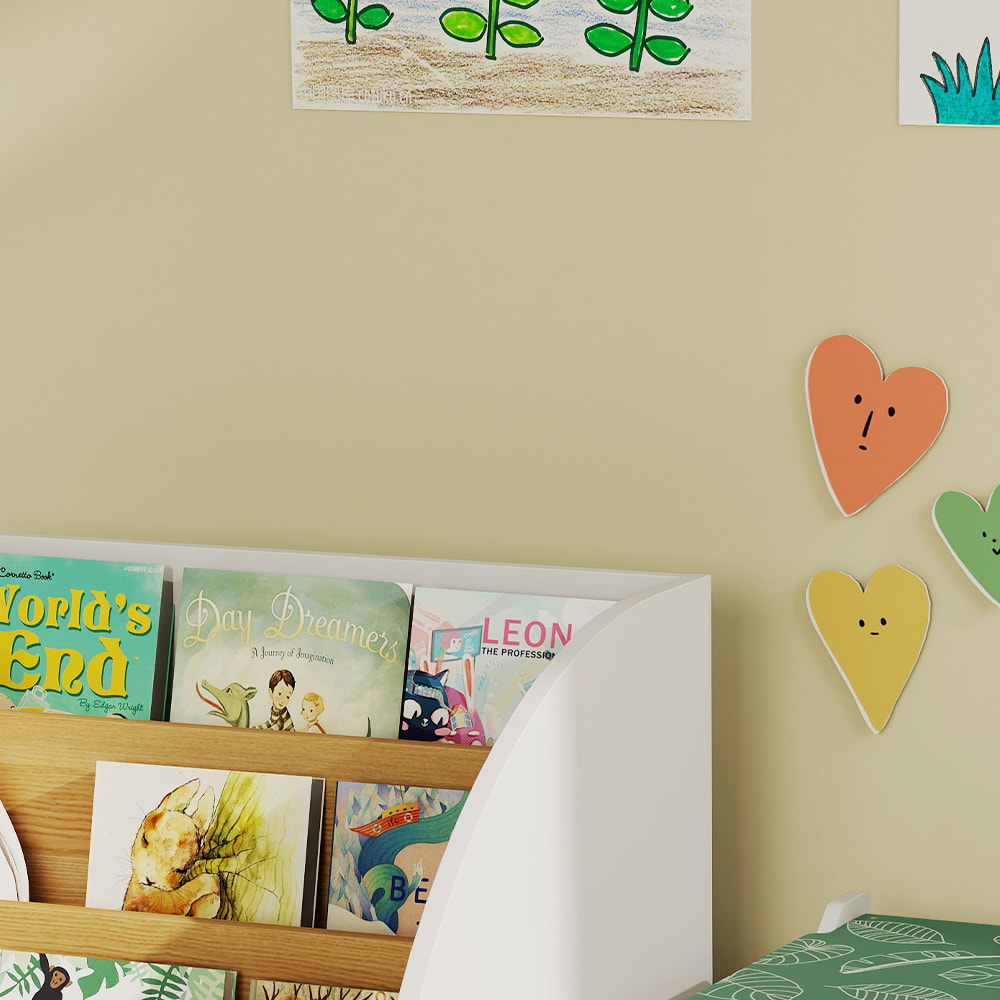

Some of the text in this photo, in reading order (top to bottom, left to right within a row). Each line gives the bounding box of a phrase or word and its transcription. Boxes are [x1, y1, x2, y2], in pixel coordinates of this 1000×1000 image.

[183, 585, 399, 664] Day Dreamers
[482, 617, 572, 649] LEON
[0, 629, 129, 699] End
[251, 646, 335, 665] A Journey of Imagination
[481, 647, 498, 656] THE
[78, 698, 144, 716] By Edgar Wright
